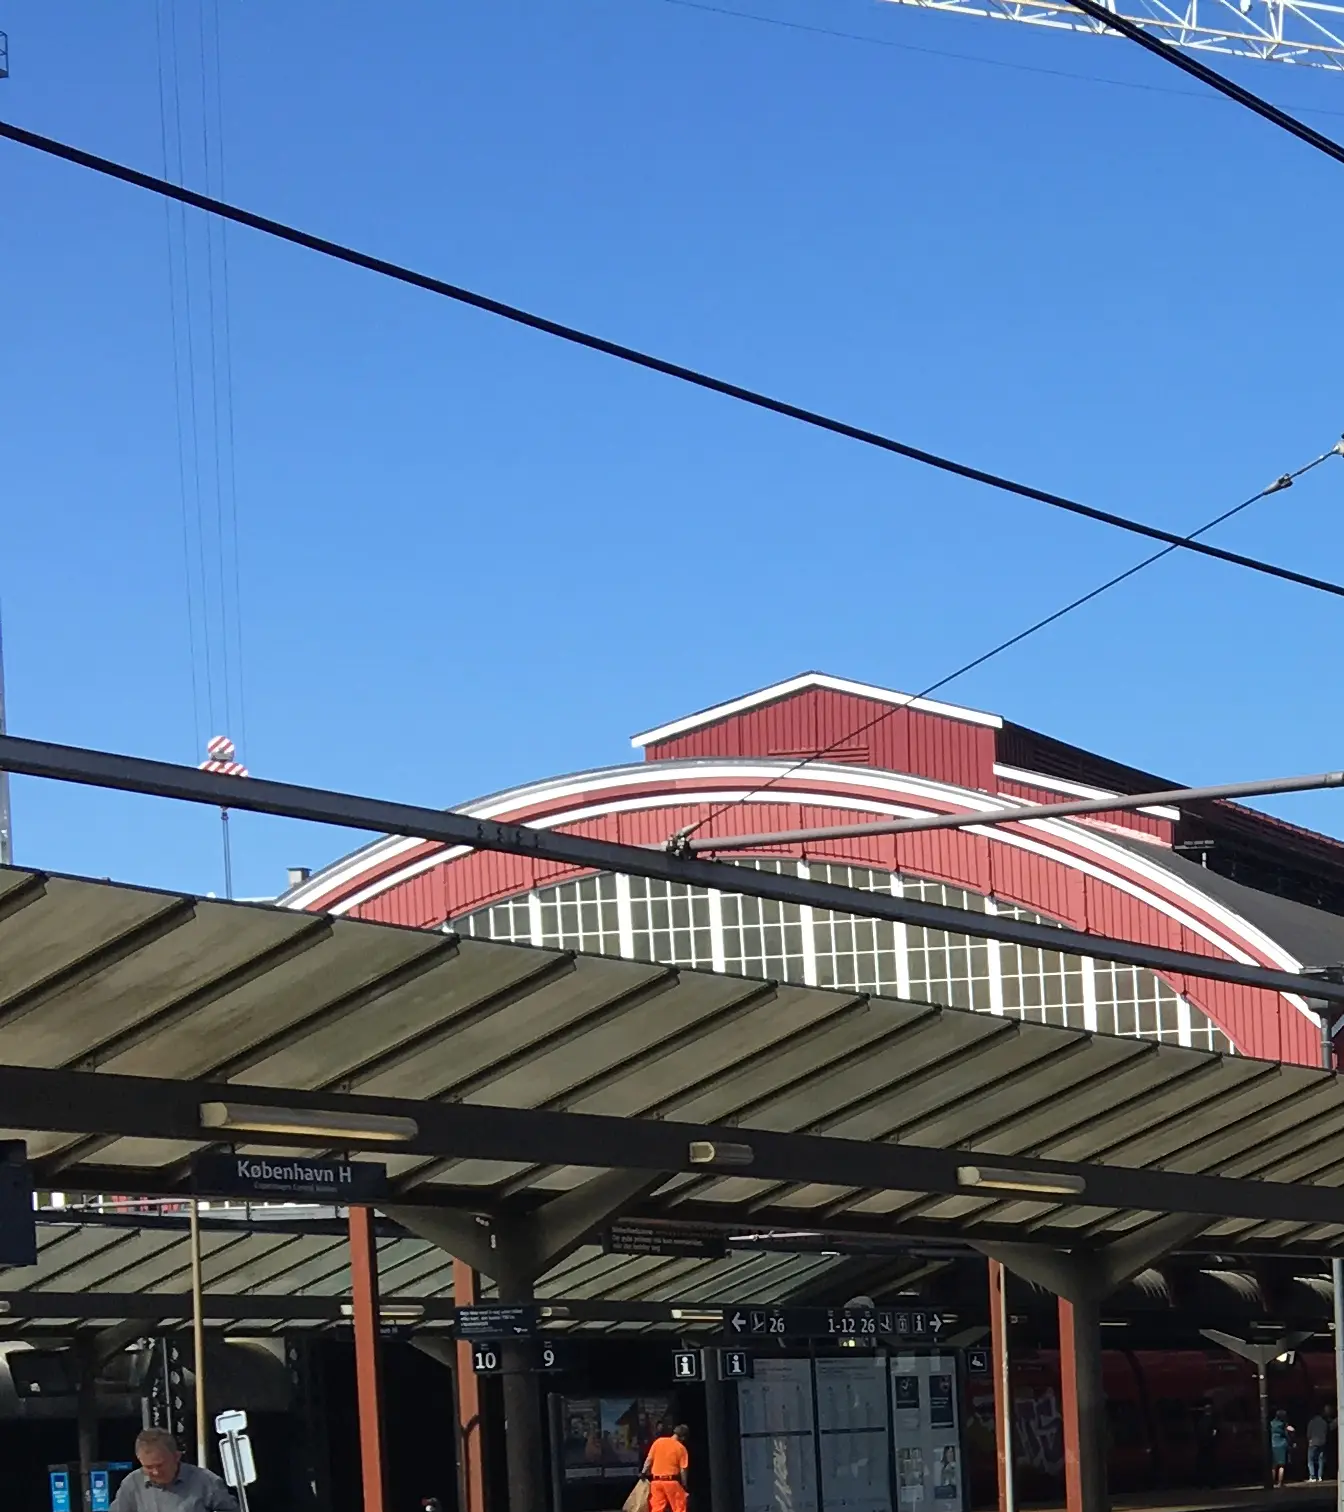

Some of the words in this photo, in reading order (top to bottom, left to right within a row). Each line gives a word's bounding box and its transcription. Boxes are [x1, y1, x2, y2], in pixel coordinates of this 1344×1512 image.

[237, 1160, 335, 1182] København
[339, 1166, 352, 1183] H
[769, 1317, 785, 1333] 26
[828, 1318, 856, 1333] 1-12
[861, 1318, 876, 1333] 26
[475, 1352, 497, 1370] 10
[543, 1349, 555, 1367] 9
